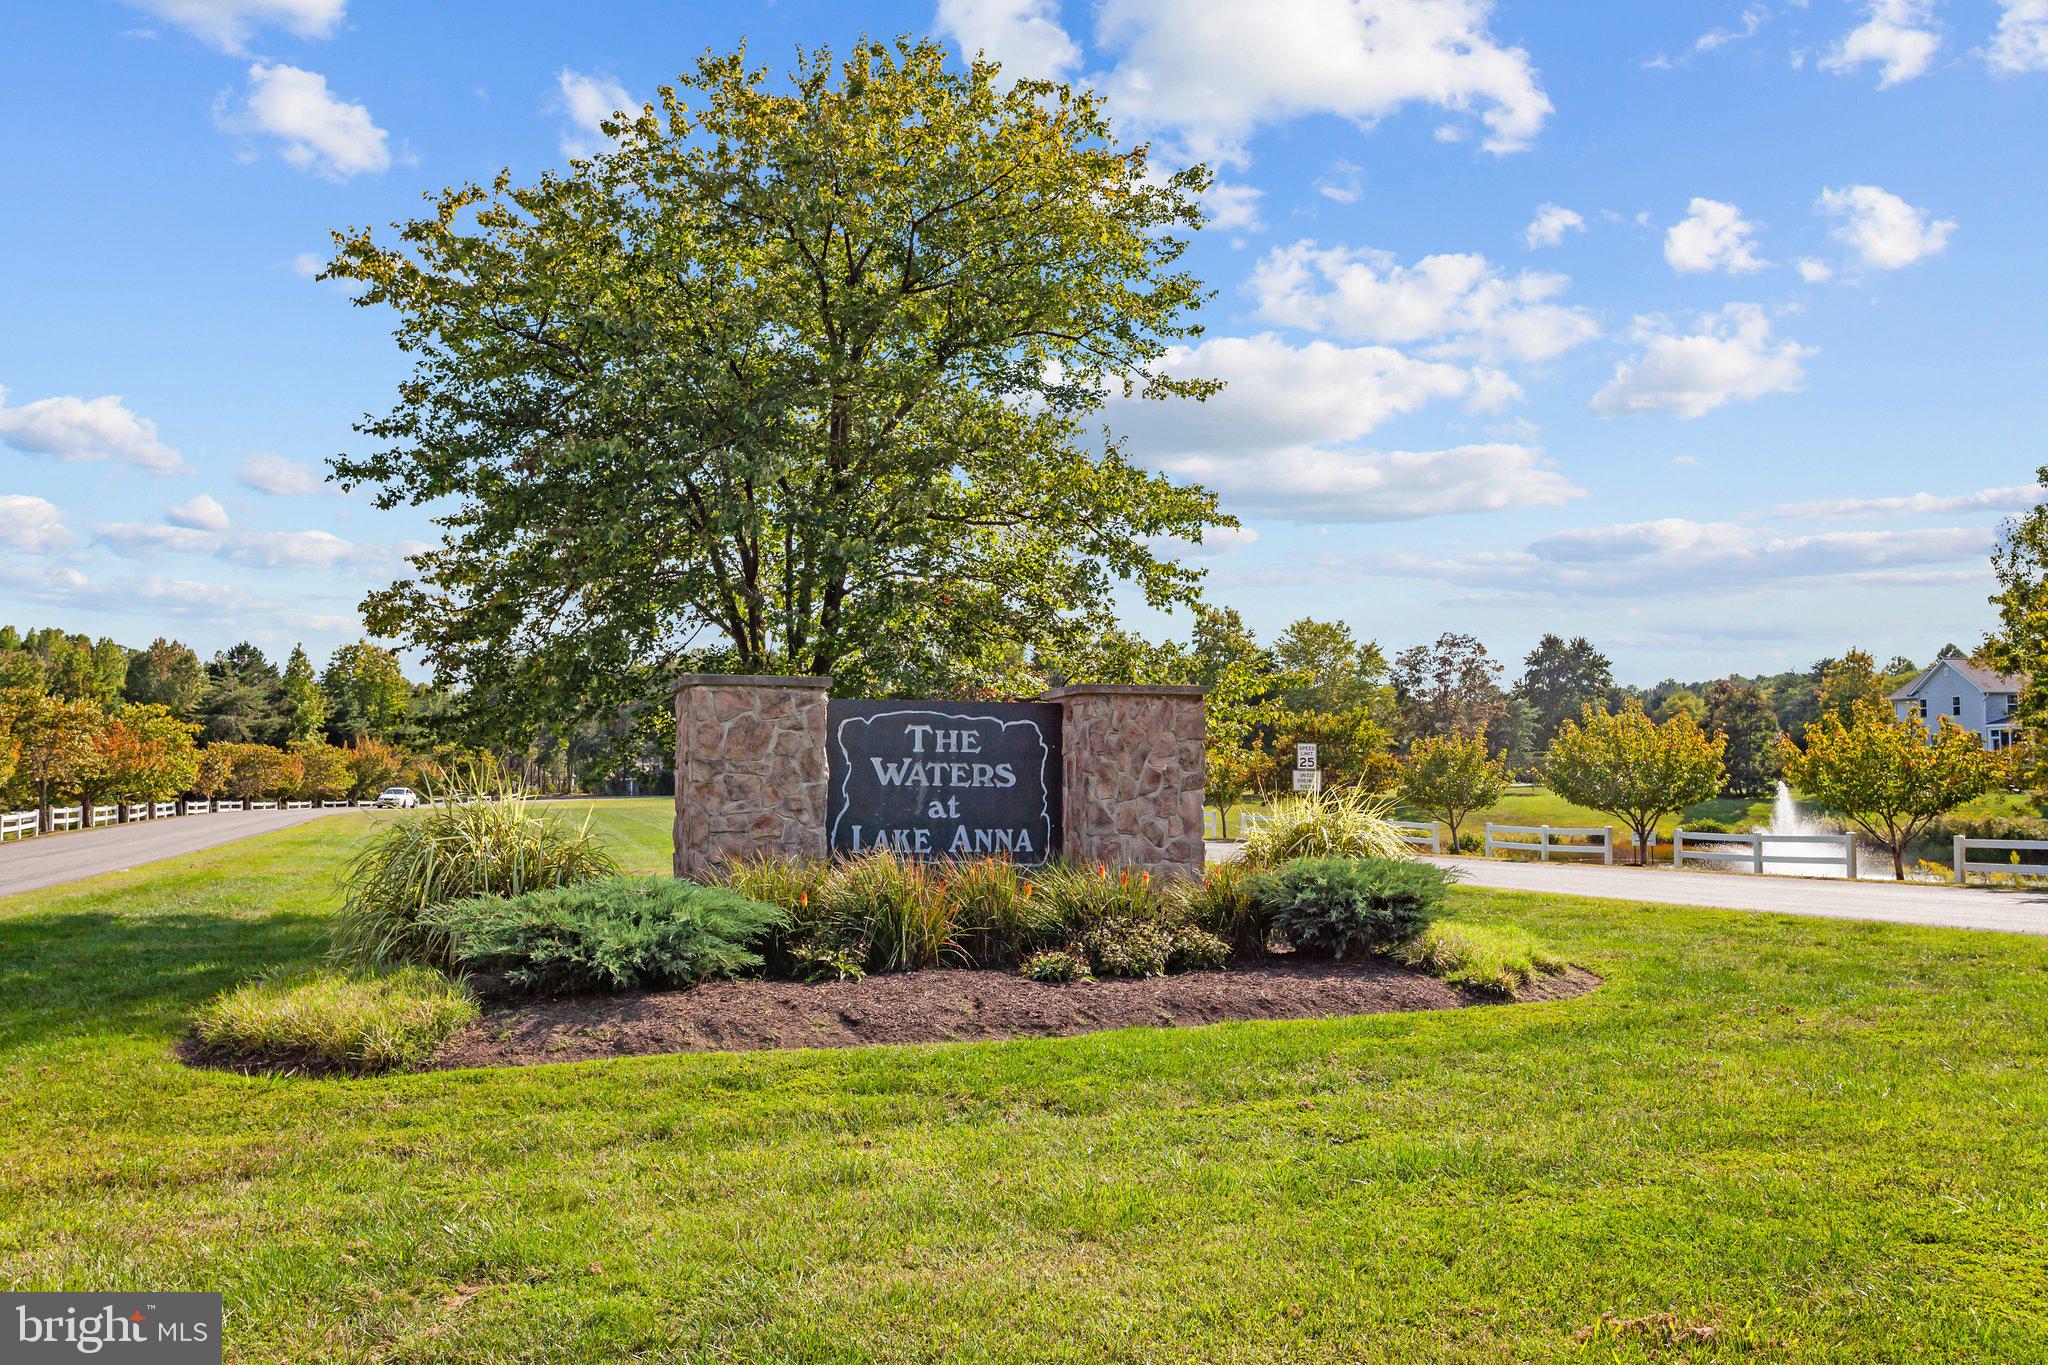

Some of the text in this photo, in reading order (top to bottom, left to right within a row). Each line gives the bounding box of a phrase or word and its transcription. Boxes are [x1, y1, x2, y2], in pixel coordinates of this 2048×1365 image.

[904, 723, 982, 754] THE
[869, 757, 1017, 788] WATERS
[1299, 757, 1315, 768] 25
[927, 794, 961, 819] at
[851, 824, 1034, 854] LAKE ANNA
